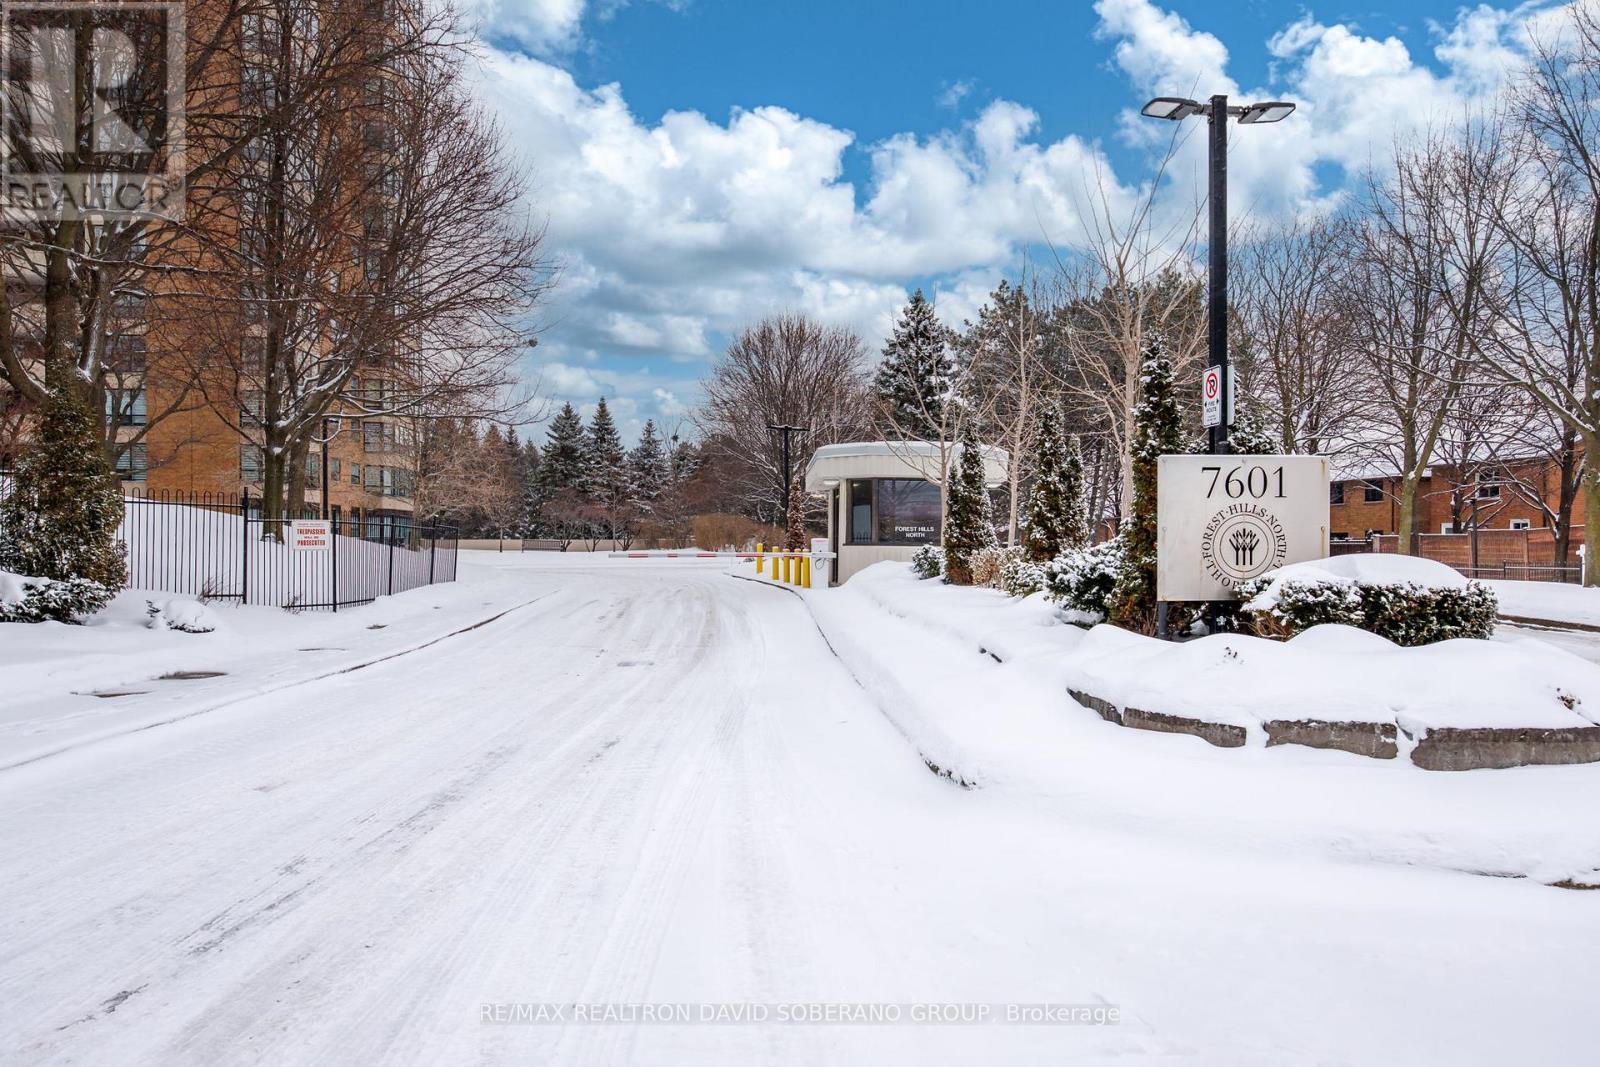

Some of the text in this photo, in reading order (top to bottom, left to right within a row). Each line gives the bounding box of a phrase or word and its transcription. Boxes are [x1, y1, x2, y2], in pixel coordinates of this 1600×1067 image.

[1201, 466, 1287, 499] 7601
[1201, 503, 1287, 561] FOREST HILLS NORTH
